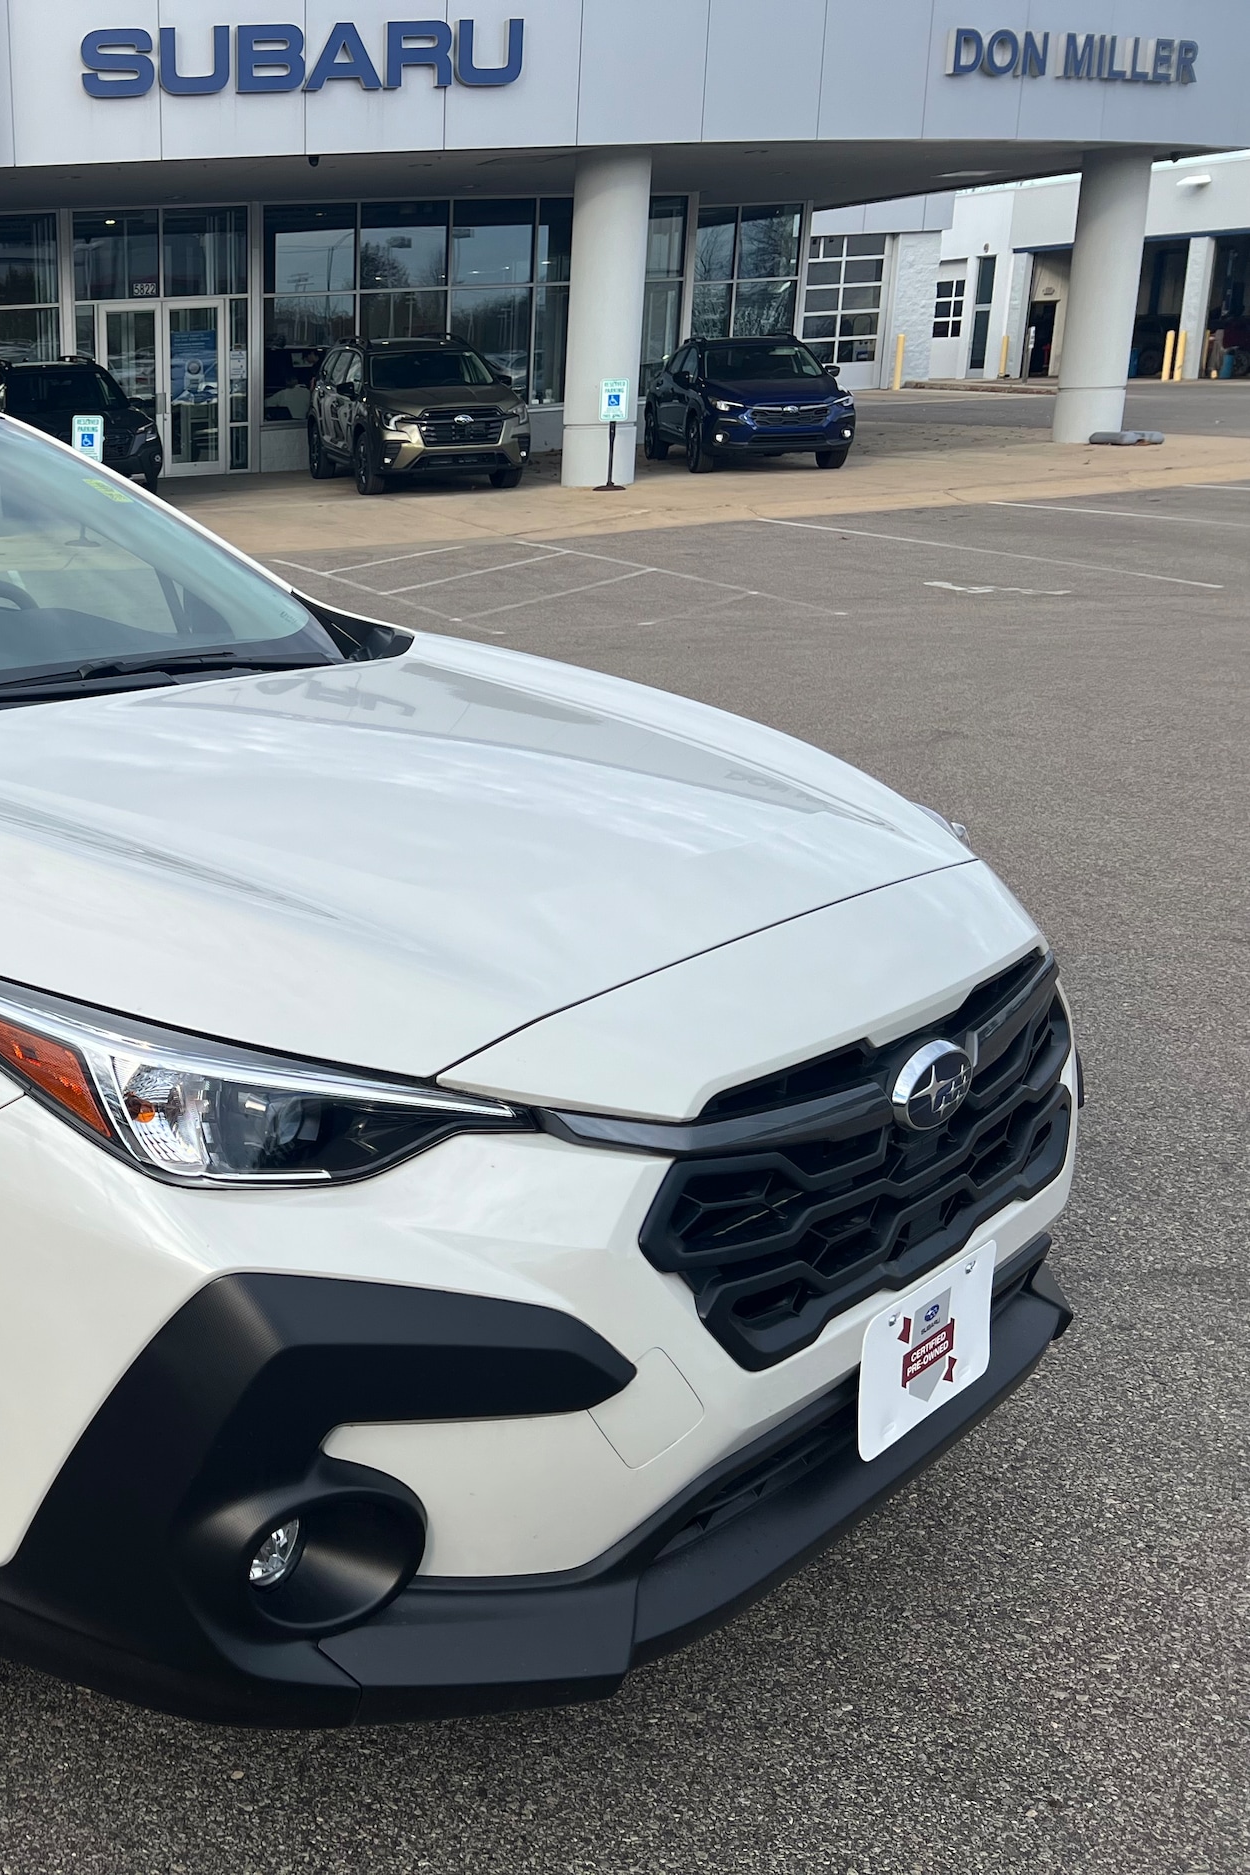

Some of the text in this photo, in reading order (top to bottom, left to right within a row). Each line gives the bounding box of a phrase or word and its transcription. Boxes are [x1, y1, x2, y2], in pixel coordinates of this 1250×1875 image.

[81, 18, 525, 97] SUBARU
[945, 27, 1200, 84] DON MILLER
[133, 283, 157, 296] 5822
[920, 1318, 941, 1335] SUBARU
[906, 1340, 949, 1377] PRE-OWNED
[911, 1331, 947, 1363] CERTIFIED
